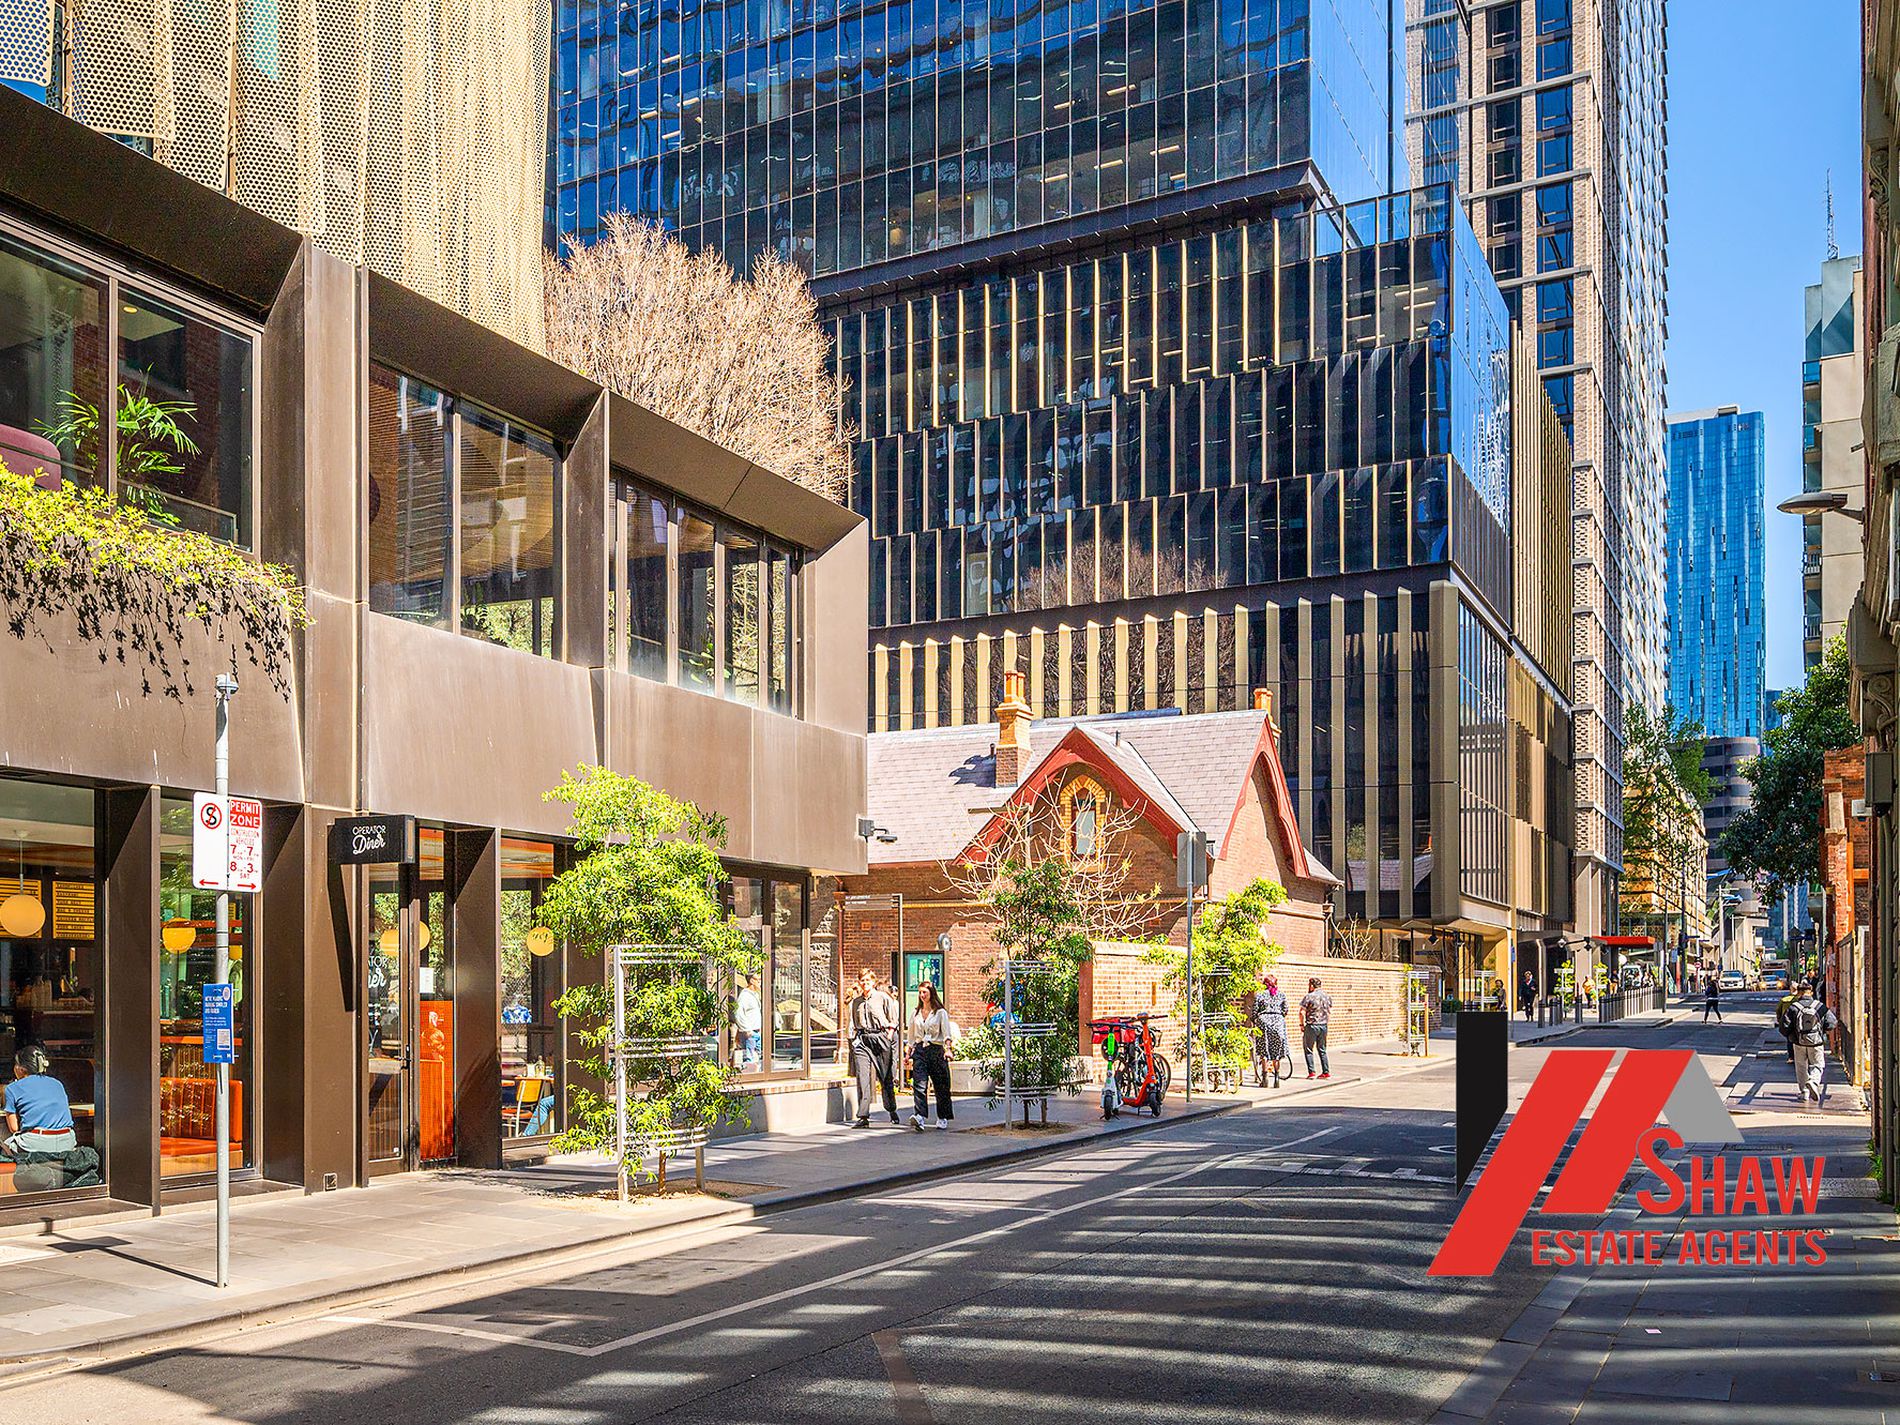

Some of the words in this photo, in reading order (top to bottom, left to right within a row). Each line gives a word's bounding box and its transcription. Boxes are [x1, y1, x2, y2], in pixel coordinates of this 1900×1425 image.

[230, 801, 260, 815] PERMIT
[230, 813, 260, 827] ZONE
[352, 825, 387, 835] OPERATOR
[352, 834, 386, 855] Diner
